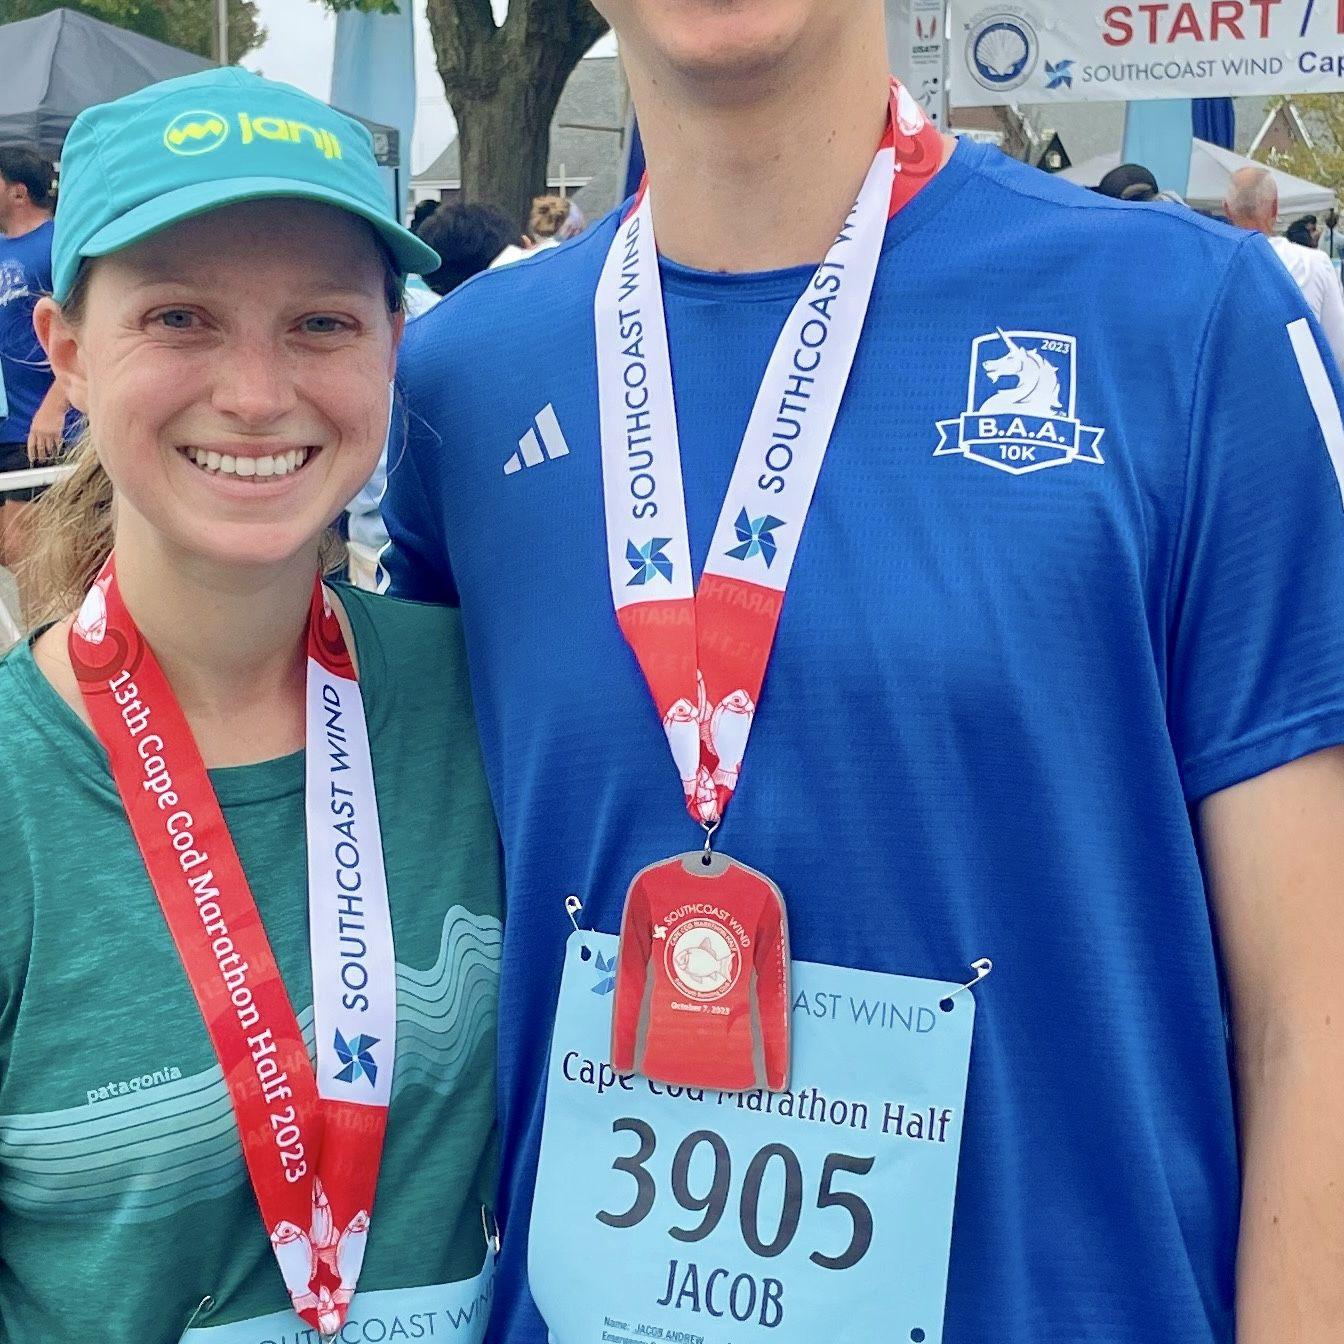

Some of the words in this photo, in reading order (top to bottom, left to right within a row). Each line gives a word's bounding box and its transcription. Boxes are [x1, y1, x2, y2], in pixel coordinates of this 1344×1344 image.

[1082, 60, 1217, 83] SOUTHCOAST
[1222, 57, 1284, 77] WIND
[618, 216, 640, 303] WIND
[758, 259, 845, 494] SOUTHCOAST
[1041, 339, 1070, 354] 2023
[619, 308, 658, 519] SOUTHCOAST
[978, 417, 1065, 443] B.A.A.
[999, 444, 1036, 461] 10K
[108, 669, 151, 737] 13th
[322, 683, 351, 773] WIND
[137, 734, 179, 810] Cape
[165, 810, 209, 872] Cod
[330, 780, 369, 1013] SOUTHCOAST
[663, 903, 731, 927] SOUTHCOAST
[728, 916, 751, 948] WIND
[187, 868, 260, 1030] Marathon
[850, 996, 937, 1033] WIND
[86, 1067, 182, 1106] patagonia
[247, 1027, 293, 1105] Half
[269, 1104, 308, 1185] 2023
[882, 1102, 953, 1143] Half
[595, 1117, 877, 1271] 3905
[657, 1259, 785, 1329] JACOB
[635, 1323, 663, 1337] JACOB
